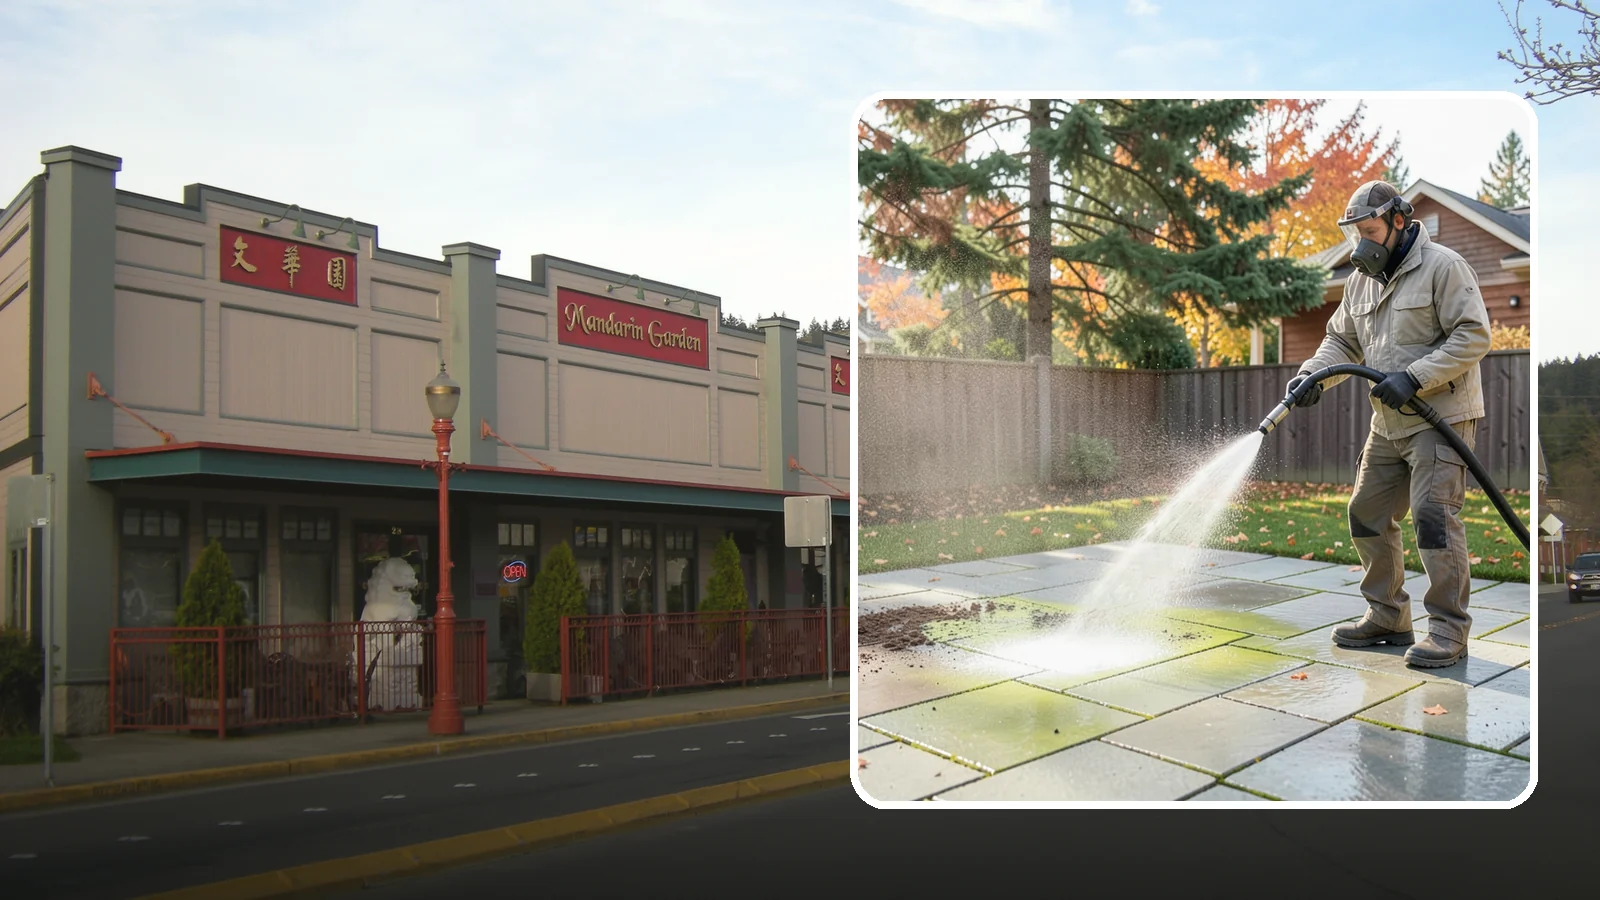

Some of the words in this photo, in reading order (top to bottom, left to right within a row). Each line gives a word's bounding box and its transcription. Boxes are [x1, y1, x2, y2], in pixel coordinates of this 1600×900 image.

[565, 302, 644, 341] Mandarin
[648, 320, 701, 352] Garden
[503, 565, 527, 578] OPEN
